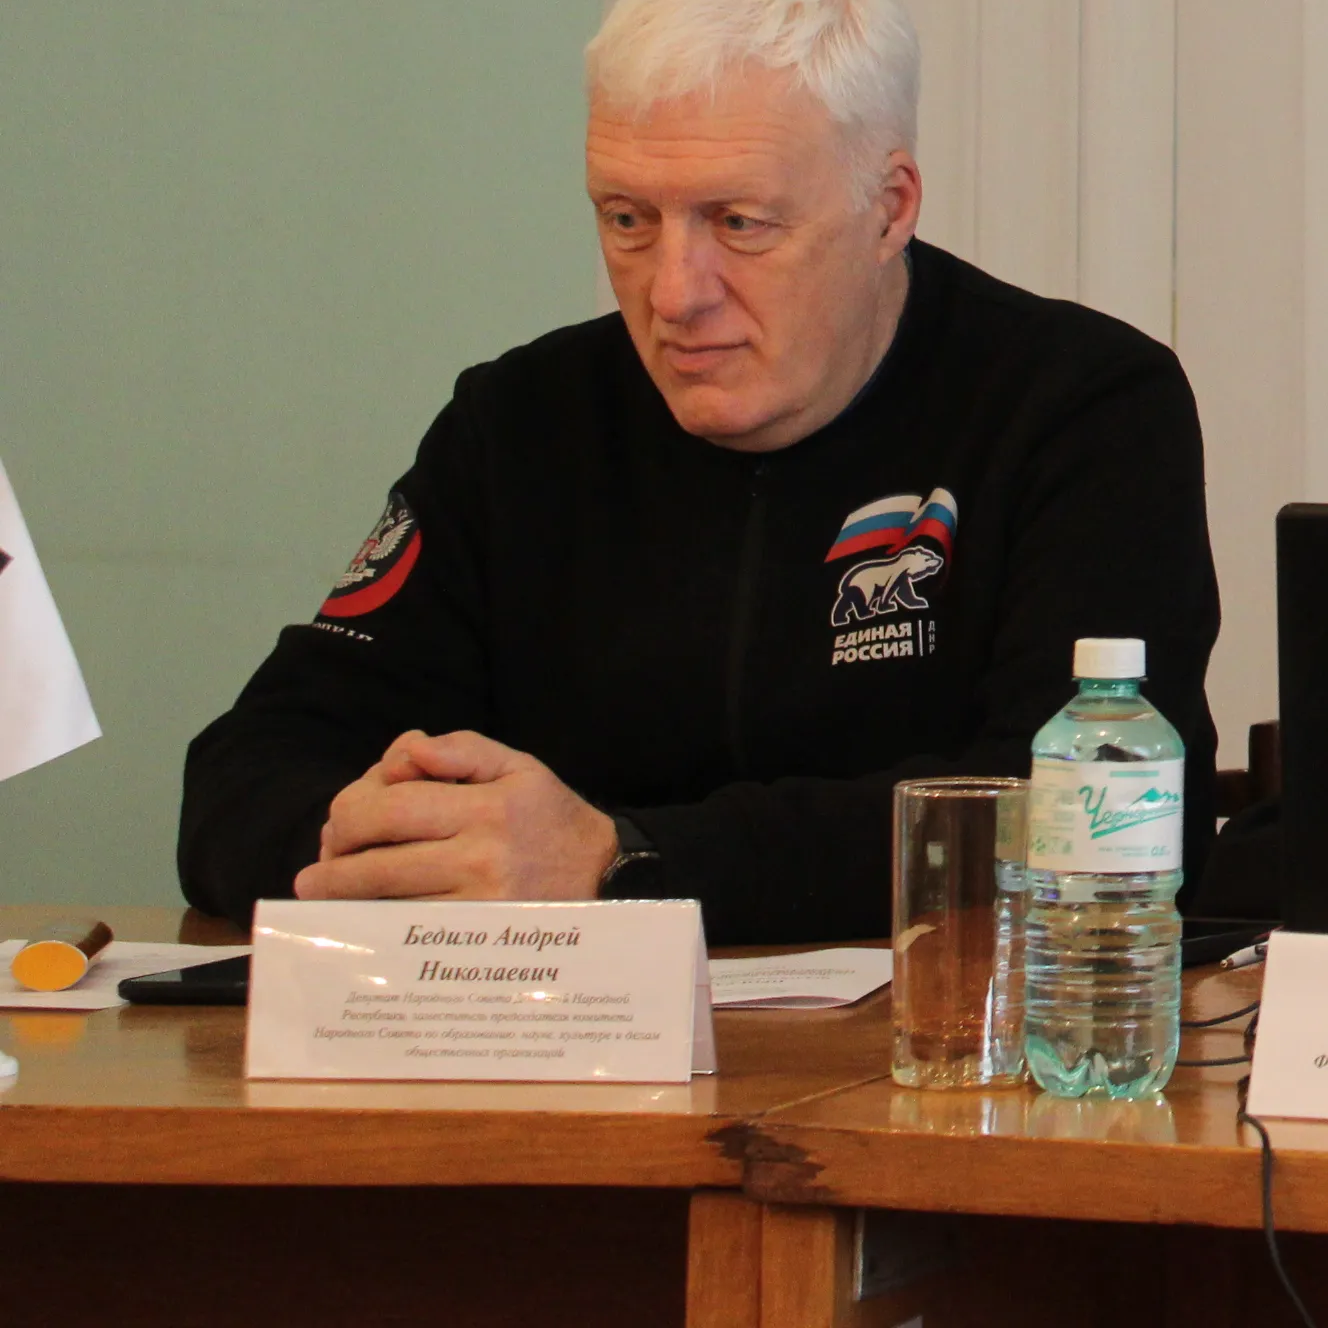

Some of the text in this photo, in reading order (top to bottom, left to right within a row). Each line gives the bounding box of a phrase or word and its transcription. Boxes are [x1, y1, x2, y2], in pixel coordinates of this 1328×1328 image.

[834, 622, 912, 648] ЕДИНАЯ
[831, 640, 913, 666] РОССИЯ
[403, 924, 581, 954] Бедило Андрей
[418, 960, 560, 982] Николаевич
[572, 992, 631, 1007] Народной
